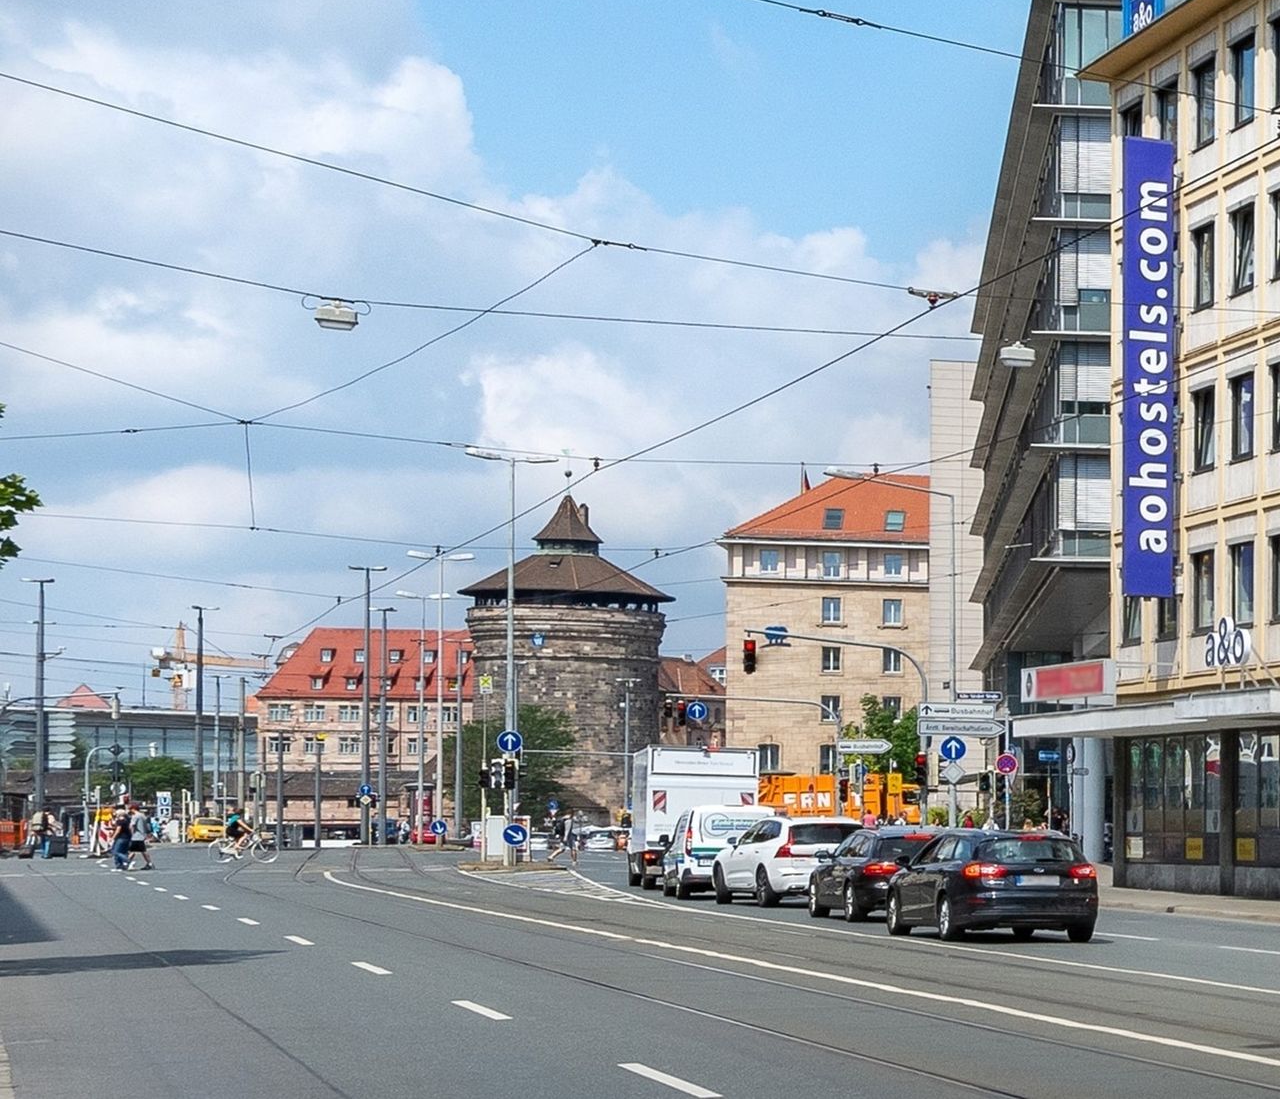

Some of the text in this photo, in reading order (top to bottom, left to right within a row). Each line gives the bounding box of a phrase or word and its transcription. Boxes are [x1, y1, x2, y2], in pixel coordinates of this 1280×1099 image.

[1132, 1, 1153, 33] a&o
[1129, 181, 1169, 554] aohostels.com
[1205, 617, 1245, 667] a&o
